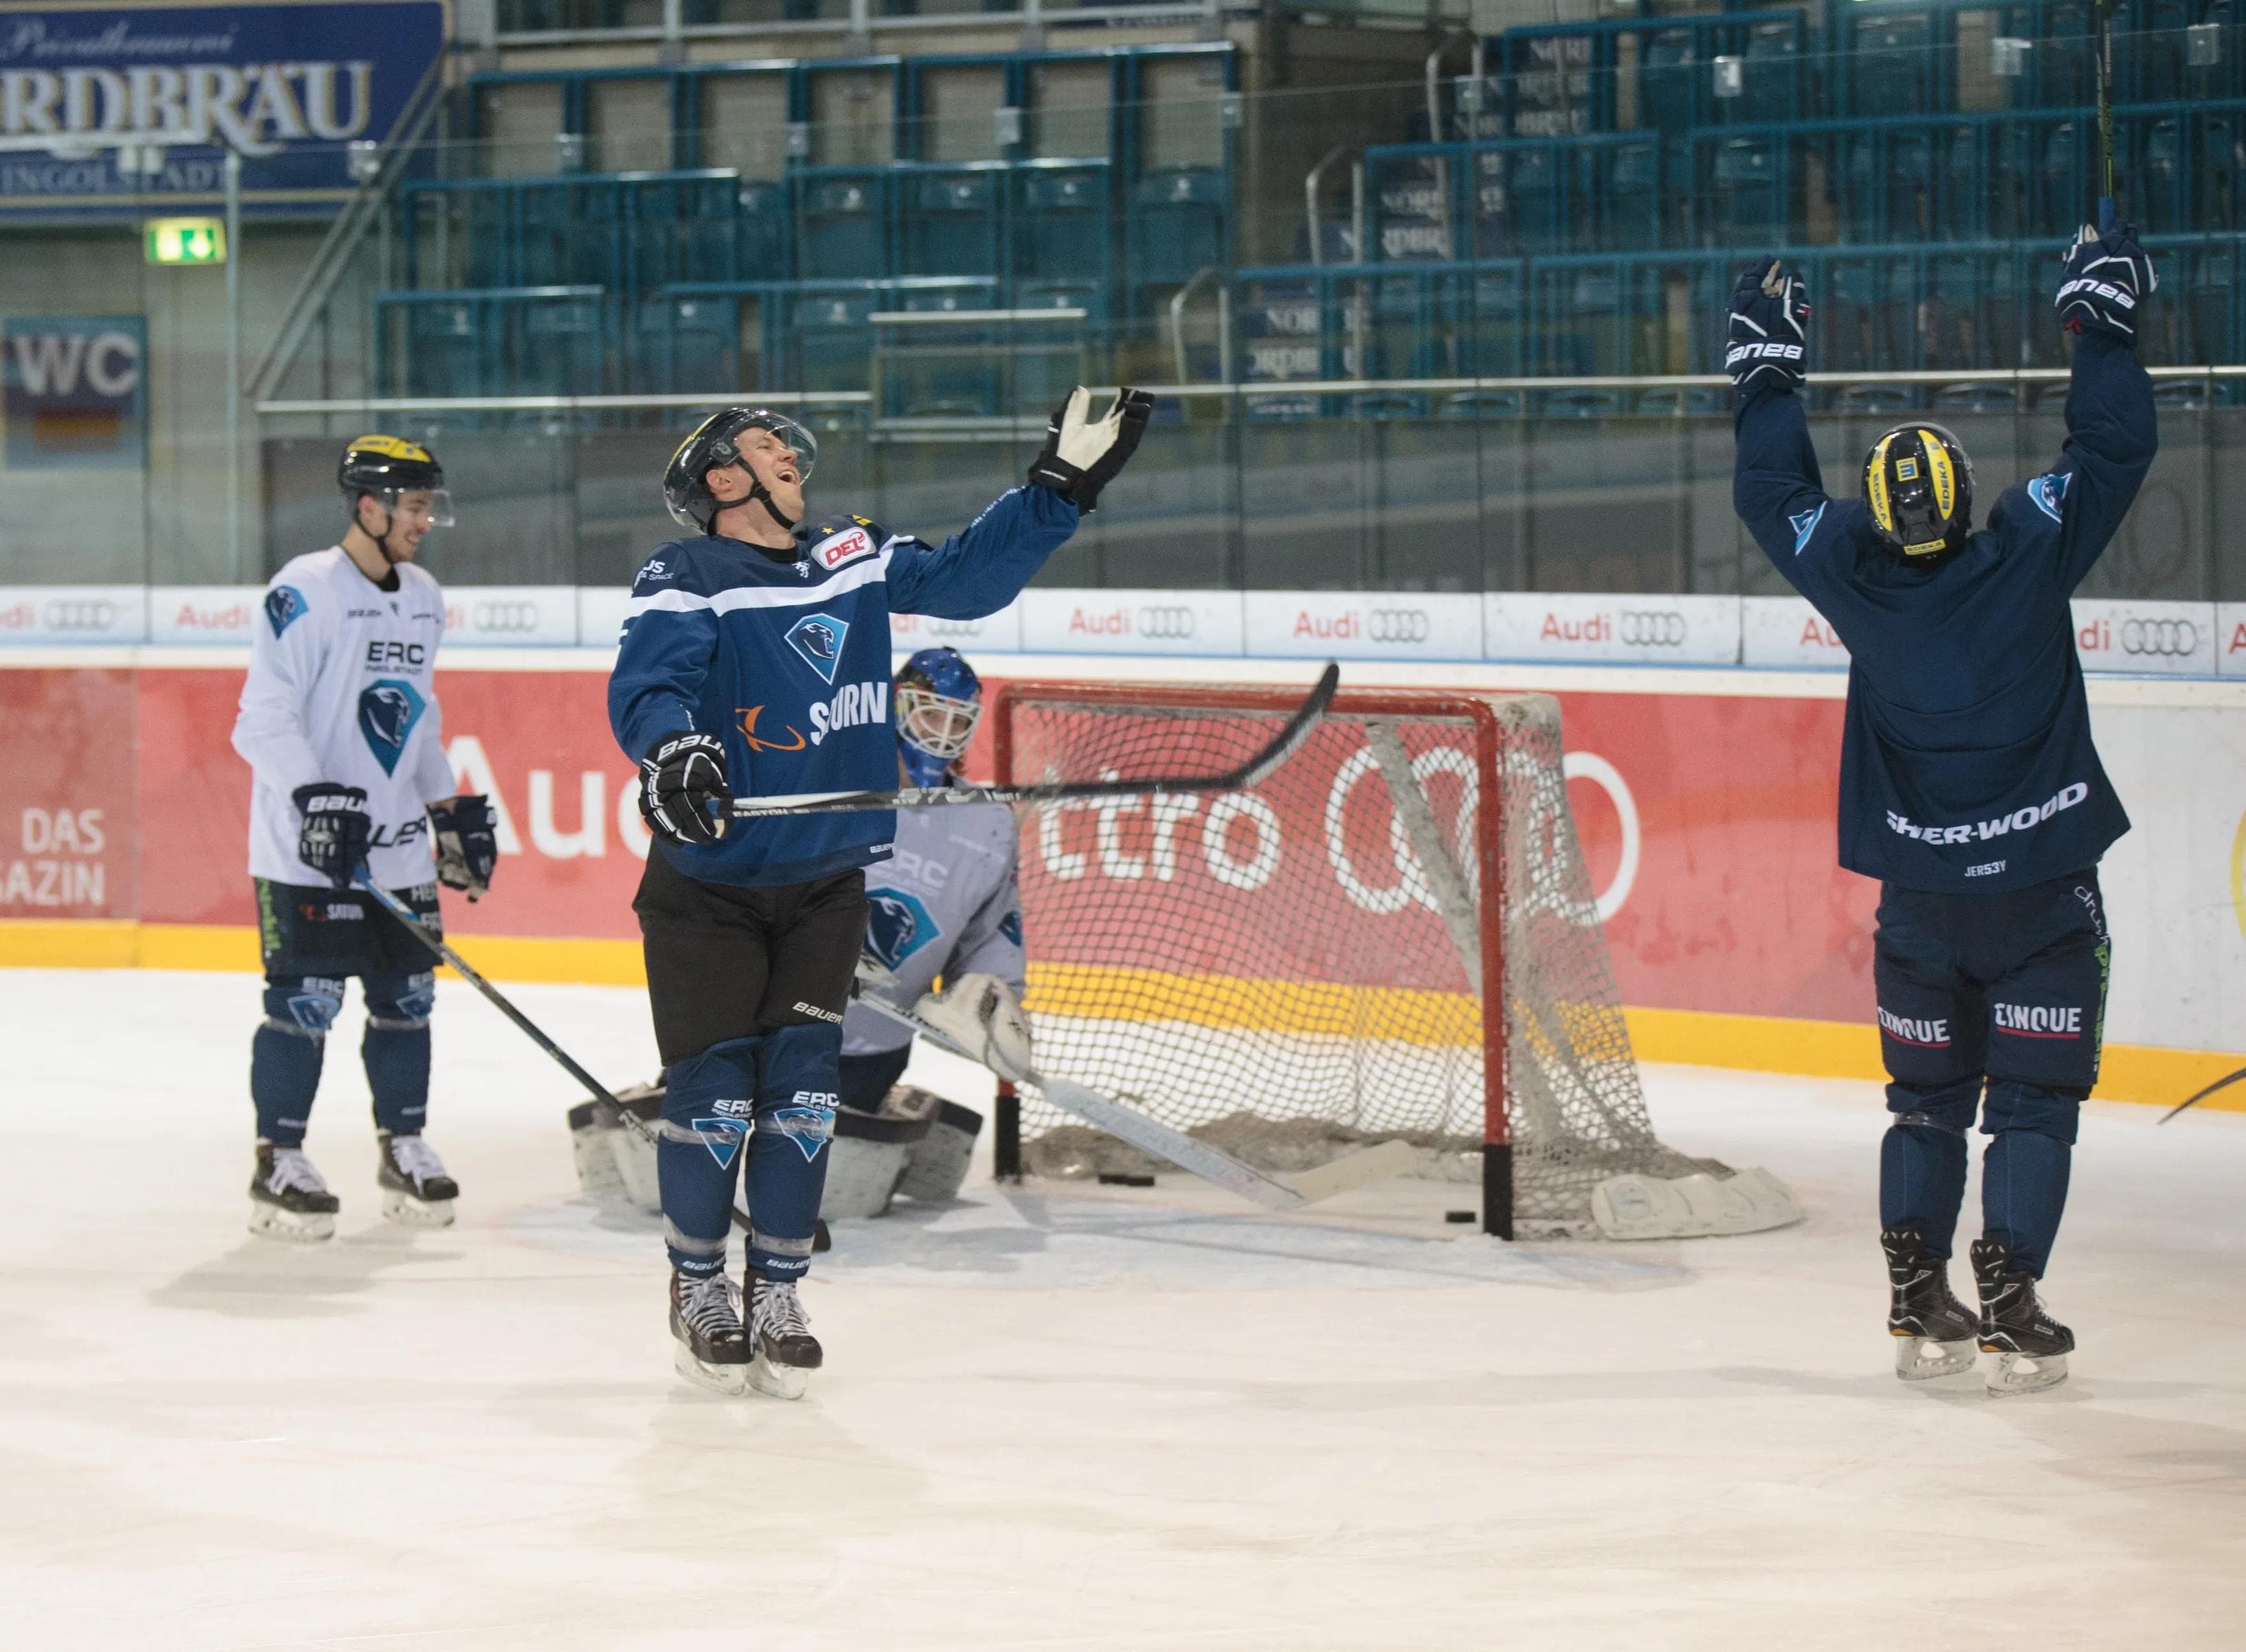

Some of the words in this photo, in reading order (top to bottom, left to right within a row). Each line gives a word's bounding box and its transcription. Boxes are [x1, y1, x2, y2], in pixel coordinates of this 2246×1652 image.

[14, 330, 138, 398] WC
[1872, 473, 1888, 522] EDEKA
[1936, 460, 1950, 511] EDEKA
[825, 531, 866, 566] DEL
[176, 602, 253, 630] Audi
[1069, 608, 1131, 635] Audi
[1294, 611, 1358, 639] Audi
[1540, 614, 1610, 642] Audi
[367, 641, 425, 666] ERC
[809, 681, 888, 746] SURN
[1886, 781, 2089, 845] SHER-WOOD
[22, 807, 105, 855] DAS
[0, 862, 105, 905] AZIN
[1964, 860, 2006, 878] JER53Y
[792, 1001, 843, 1024] BAUER
[1877, 1005, 1951, 1043] CINQUE
[1995, 1002, 2082, 1032] CINQUE
[792, 1090, 841, 1108] ERC
